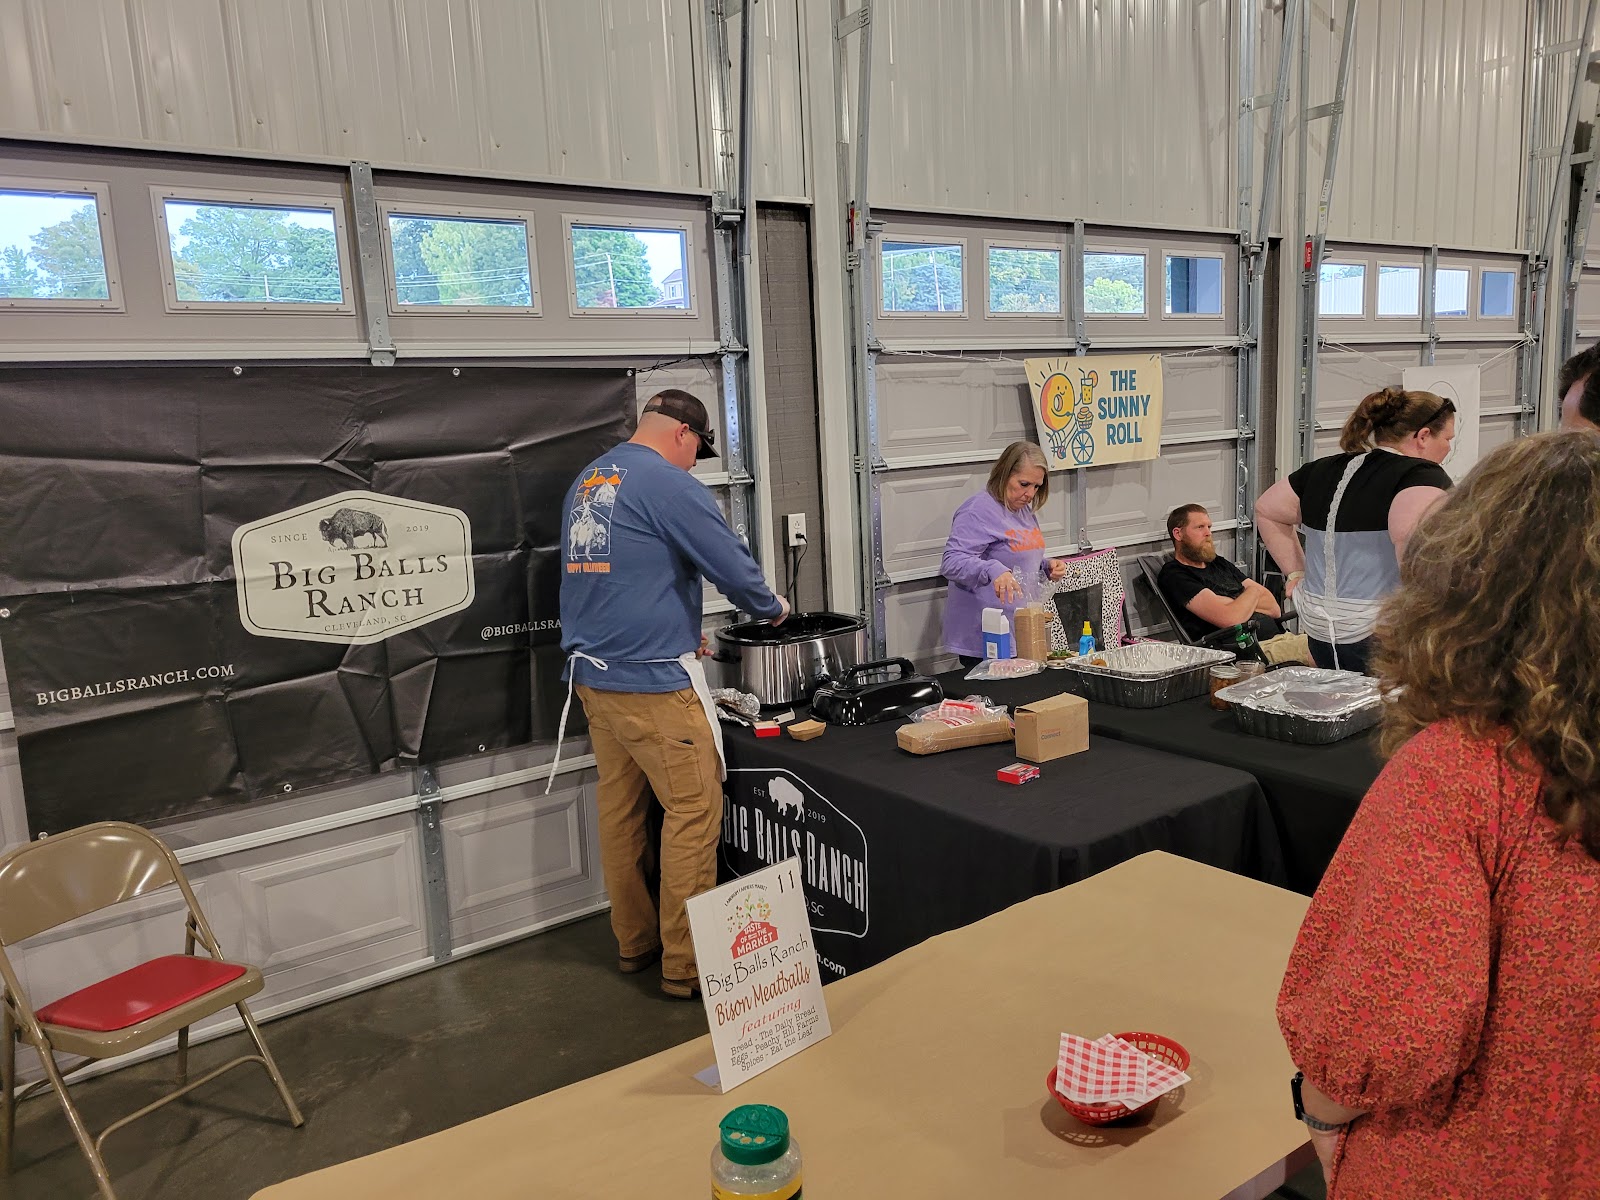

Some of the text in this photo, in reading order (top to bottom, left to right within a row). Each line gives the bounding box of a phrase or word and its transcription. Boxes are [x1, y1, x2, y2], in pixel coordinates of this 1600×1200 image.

[1110, 370, 1136, 391] THE
[1098, 395, 1150, 420] SUNNY
[1106, 422, 1142, 446] ROLL
[270, 533, 308, 544] SINCE
[269, 552, 448, 590] BIG BALLS
[304, 588, 424, 619] RANCH
[324, 616, 391, 632] CLEVELAND,
[36, 664, 235, 705] BIGBALLSRANCH.COM
[754, 787, 767, 799] EST.
[808, 808, 826, 823] 2019
[723, 794, 748, 852] BIG
[807, 831, 864, 912] RANCH
[744, 922, 761, 934] TASTE
[758, 928, 767, 936] THE
[737, 932, 773, 956] MARKET
[706, 933, 808, 997] Big Balls Ranch
[715, 961, 810, 1026] Bison Meatballs
[731, 1038, 753, 1056] Bread
[759, 1028, 773, 1040] The
[774, 1018, 793, 1032] Daily
[795, 1006, 816, 1022] Bread
[738, 999, 801, 1041] featuring
[731, 1052, 748, 1067] Eggs
[755, 1034, 780, 1053] Peachy
[782, 1025, 795, 1039] Hill
[796, 1014, 820, 1030] Farms
[741, 1054, 764, 1071] Spices
[770, 1045, 783, 1055] Eat
[784, 1036, 796, 1048] the
[798, 1026, 813, 1040] Leaf
